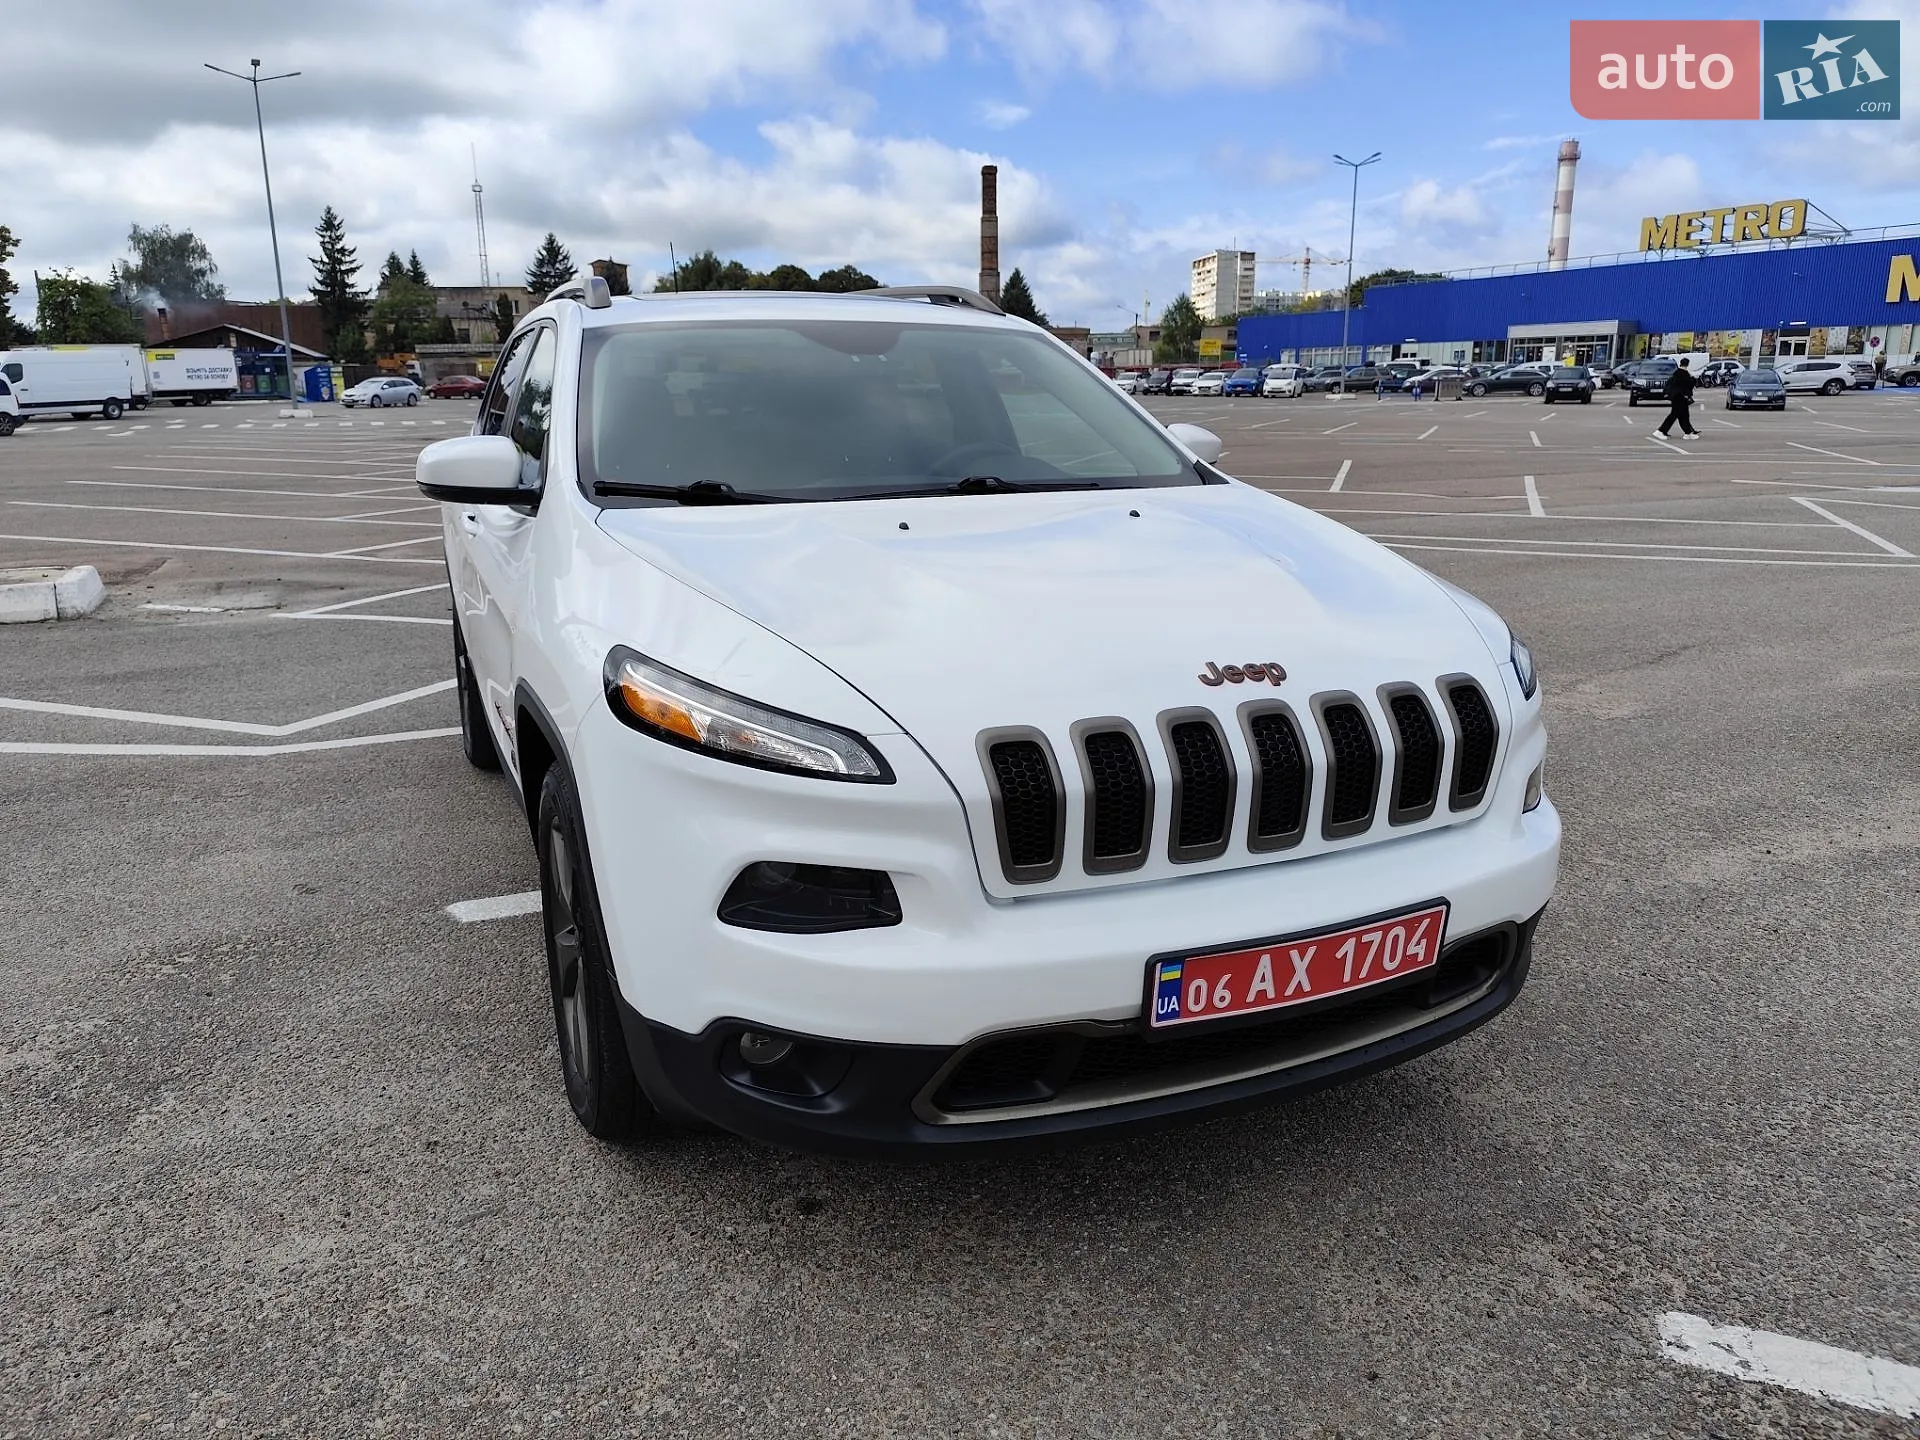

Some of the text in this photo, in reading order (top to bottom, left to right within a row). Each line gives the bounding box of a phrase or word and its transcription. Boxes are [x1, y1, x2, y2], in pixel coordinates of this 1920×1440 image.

[1639, 199, 1808, 251] METRO
[1198, 661, 1287, 687] Jeep
[1187, 918, 1432, 1013] 06 AX 1704
[1157, 995, 1179, 1014] UA
